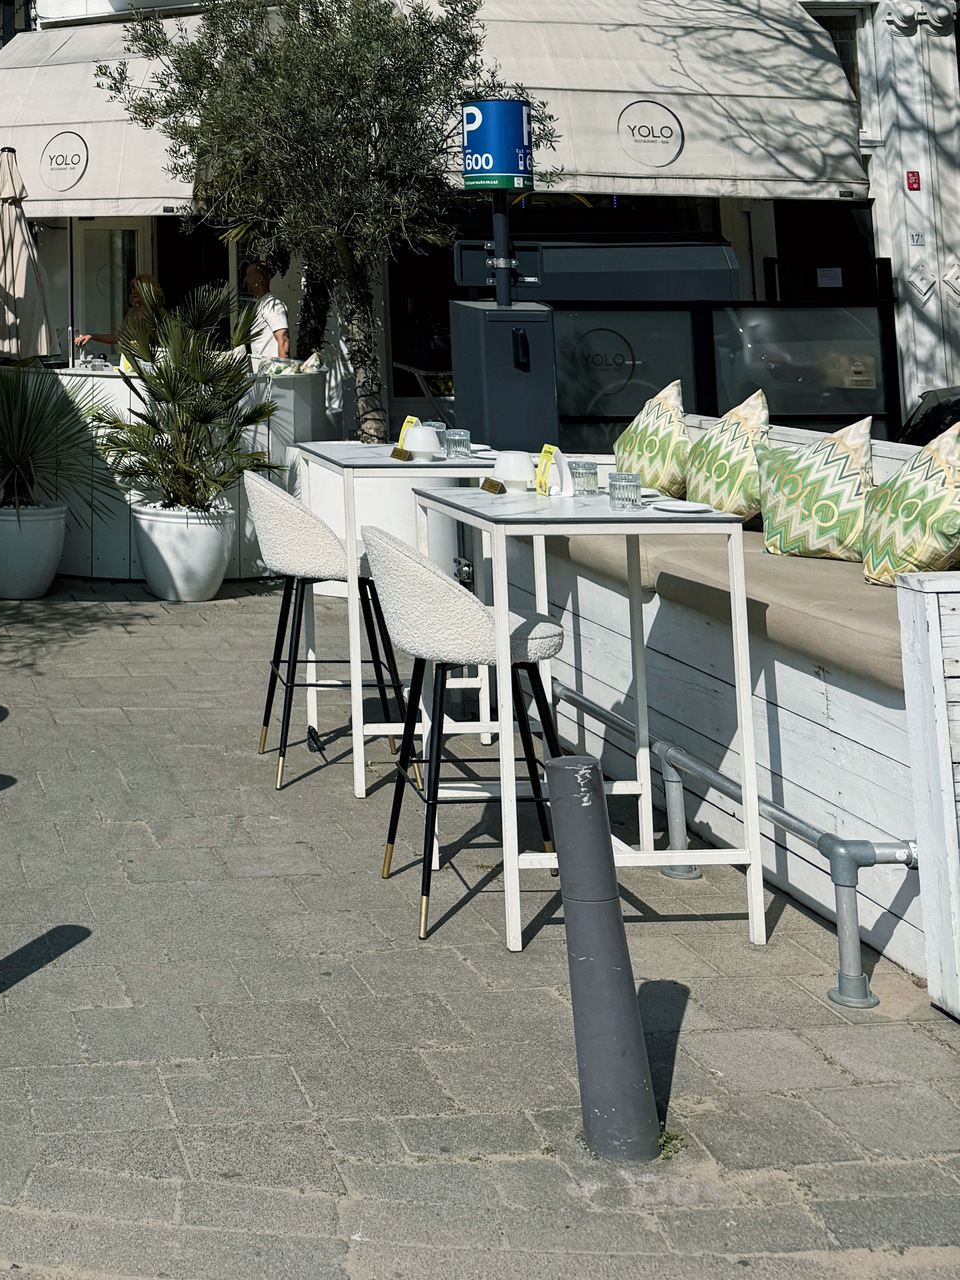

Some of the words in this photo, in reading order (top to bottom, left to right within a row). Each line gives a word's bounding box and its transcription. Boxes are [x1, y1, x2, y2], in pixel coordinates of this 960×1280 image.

[462, 105, 483, 147] P
[627, 124, 673, 139] YOLO
[48, 153, 81, 167] YOLO
[465, 153, 494, 171] 600
